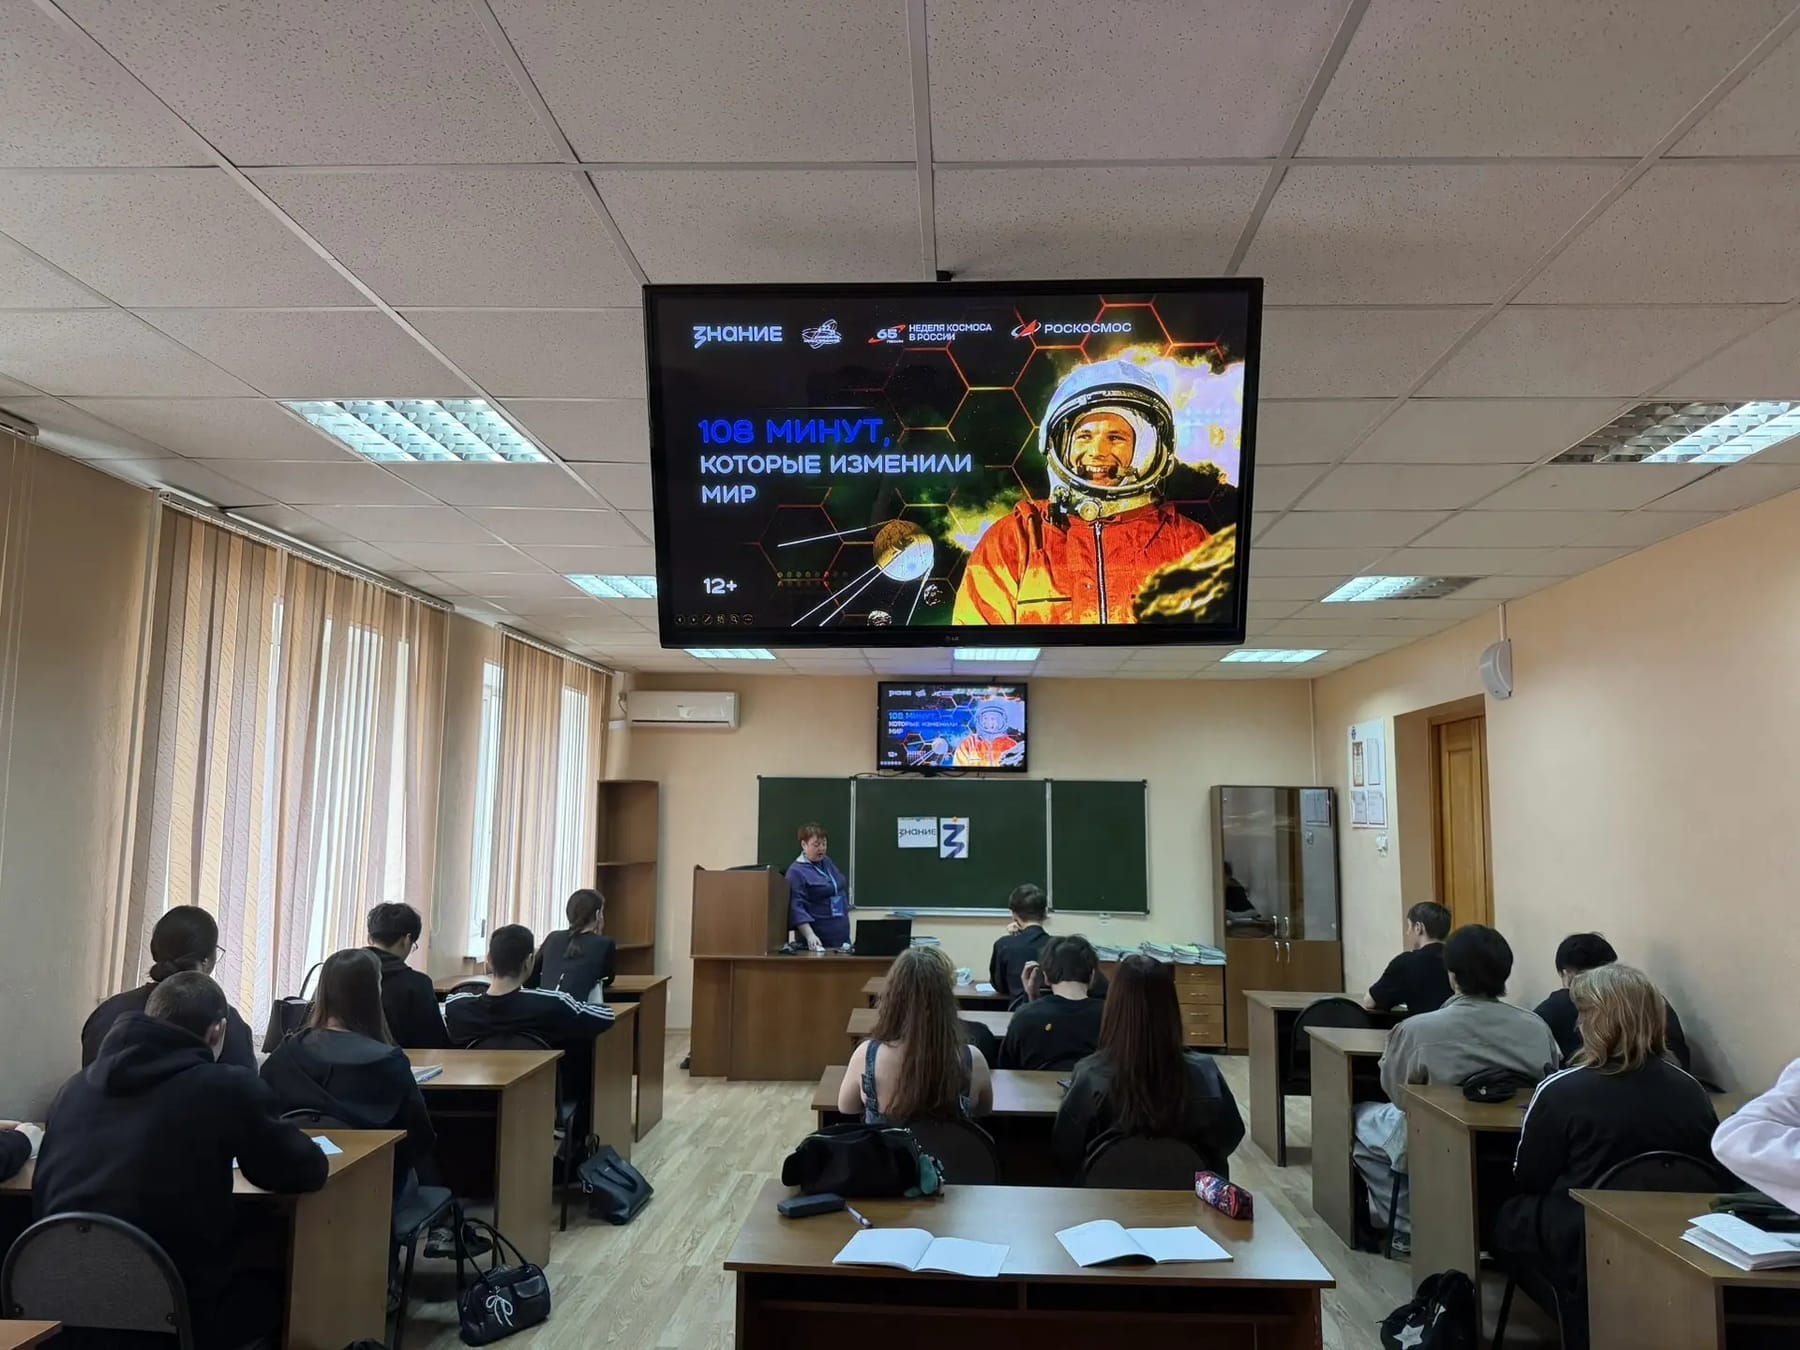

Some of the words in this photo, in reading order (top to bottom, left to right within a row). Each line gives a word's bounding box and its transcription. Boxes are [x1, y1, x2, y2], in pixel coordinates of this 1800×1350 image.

[876, 328, 898, 340] 65
[909, 324, 946, 332] НЕДЕЛЯ
[947, 323, 992, 332] КОСМОСА
[1044, 322, 1132, 334] РОСКОСМОС
[909, 333, 915, 341] В
[917, 333, 956, 341] РОССИИ
[698, 419, 754, 444] 108
[766, 418, 892, 448] МИНУТ,
[700, 455, 822, 474] КОТОРЫЕ
[830, 454, 972, 473] ИЗМЕНИЛИ
[702, 485, 756, 503] МИР
[703, 577, 738, 594] 12+
